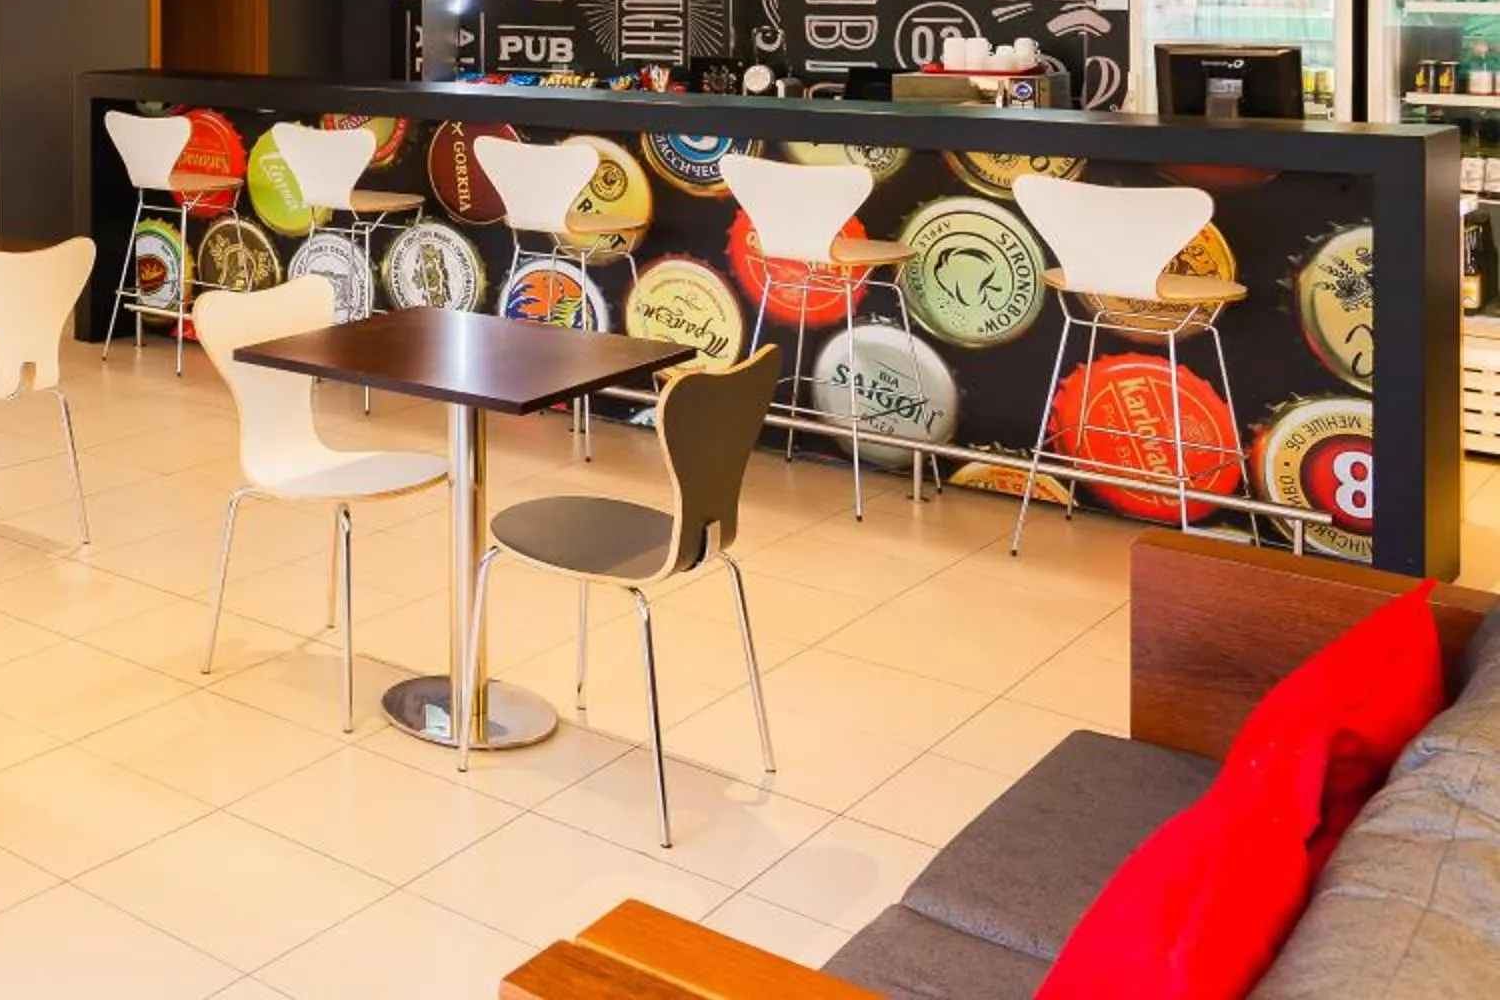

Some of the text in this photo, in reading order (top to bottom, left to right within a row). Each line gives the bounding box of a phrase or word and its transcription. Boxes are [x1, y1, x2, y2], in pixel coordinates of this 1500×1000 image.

[499, 35, 574, 63] PUB
[453, 141, 472, 214] GORKHA
[984, 231, 1032, 335] STRONGBOW
